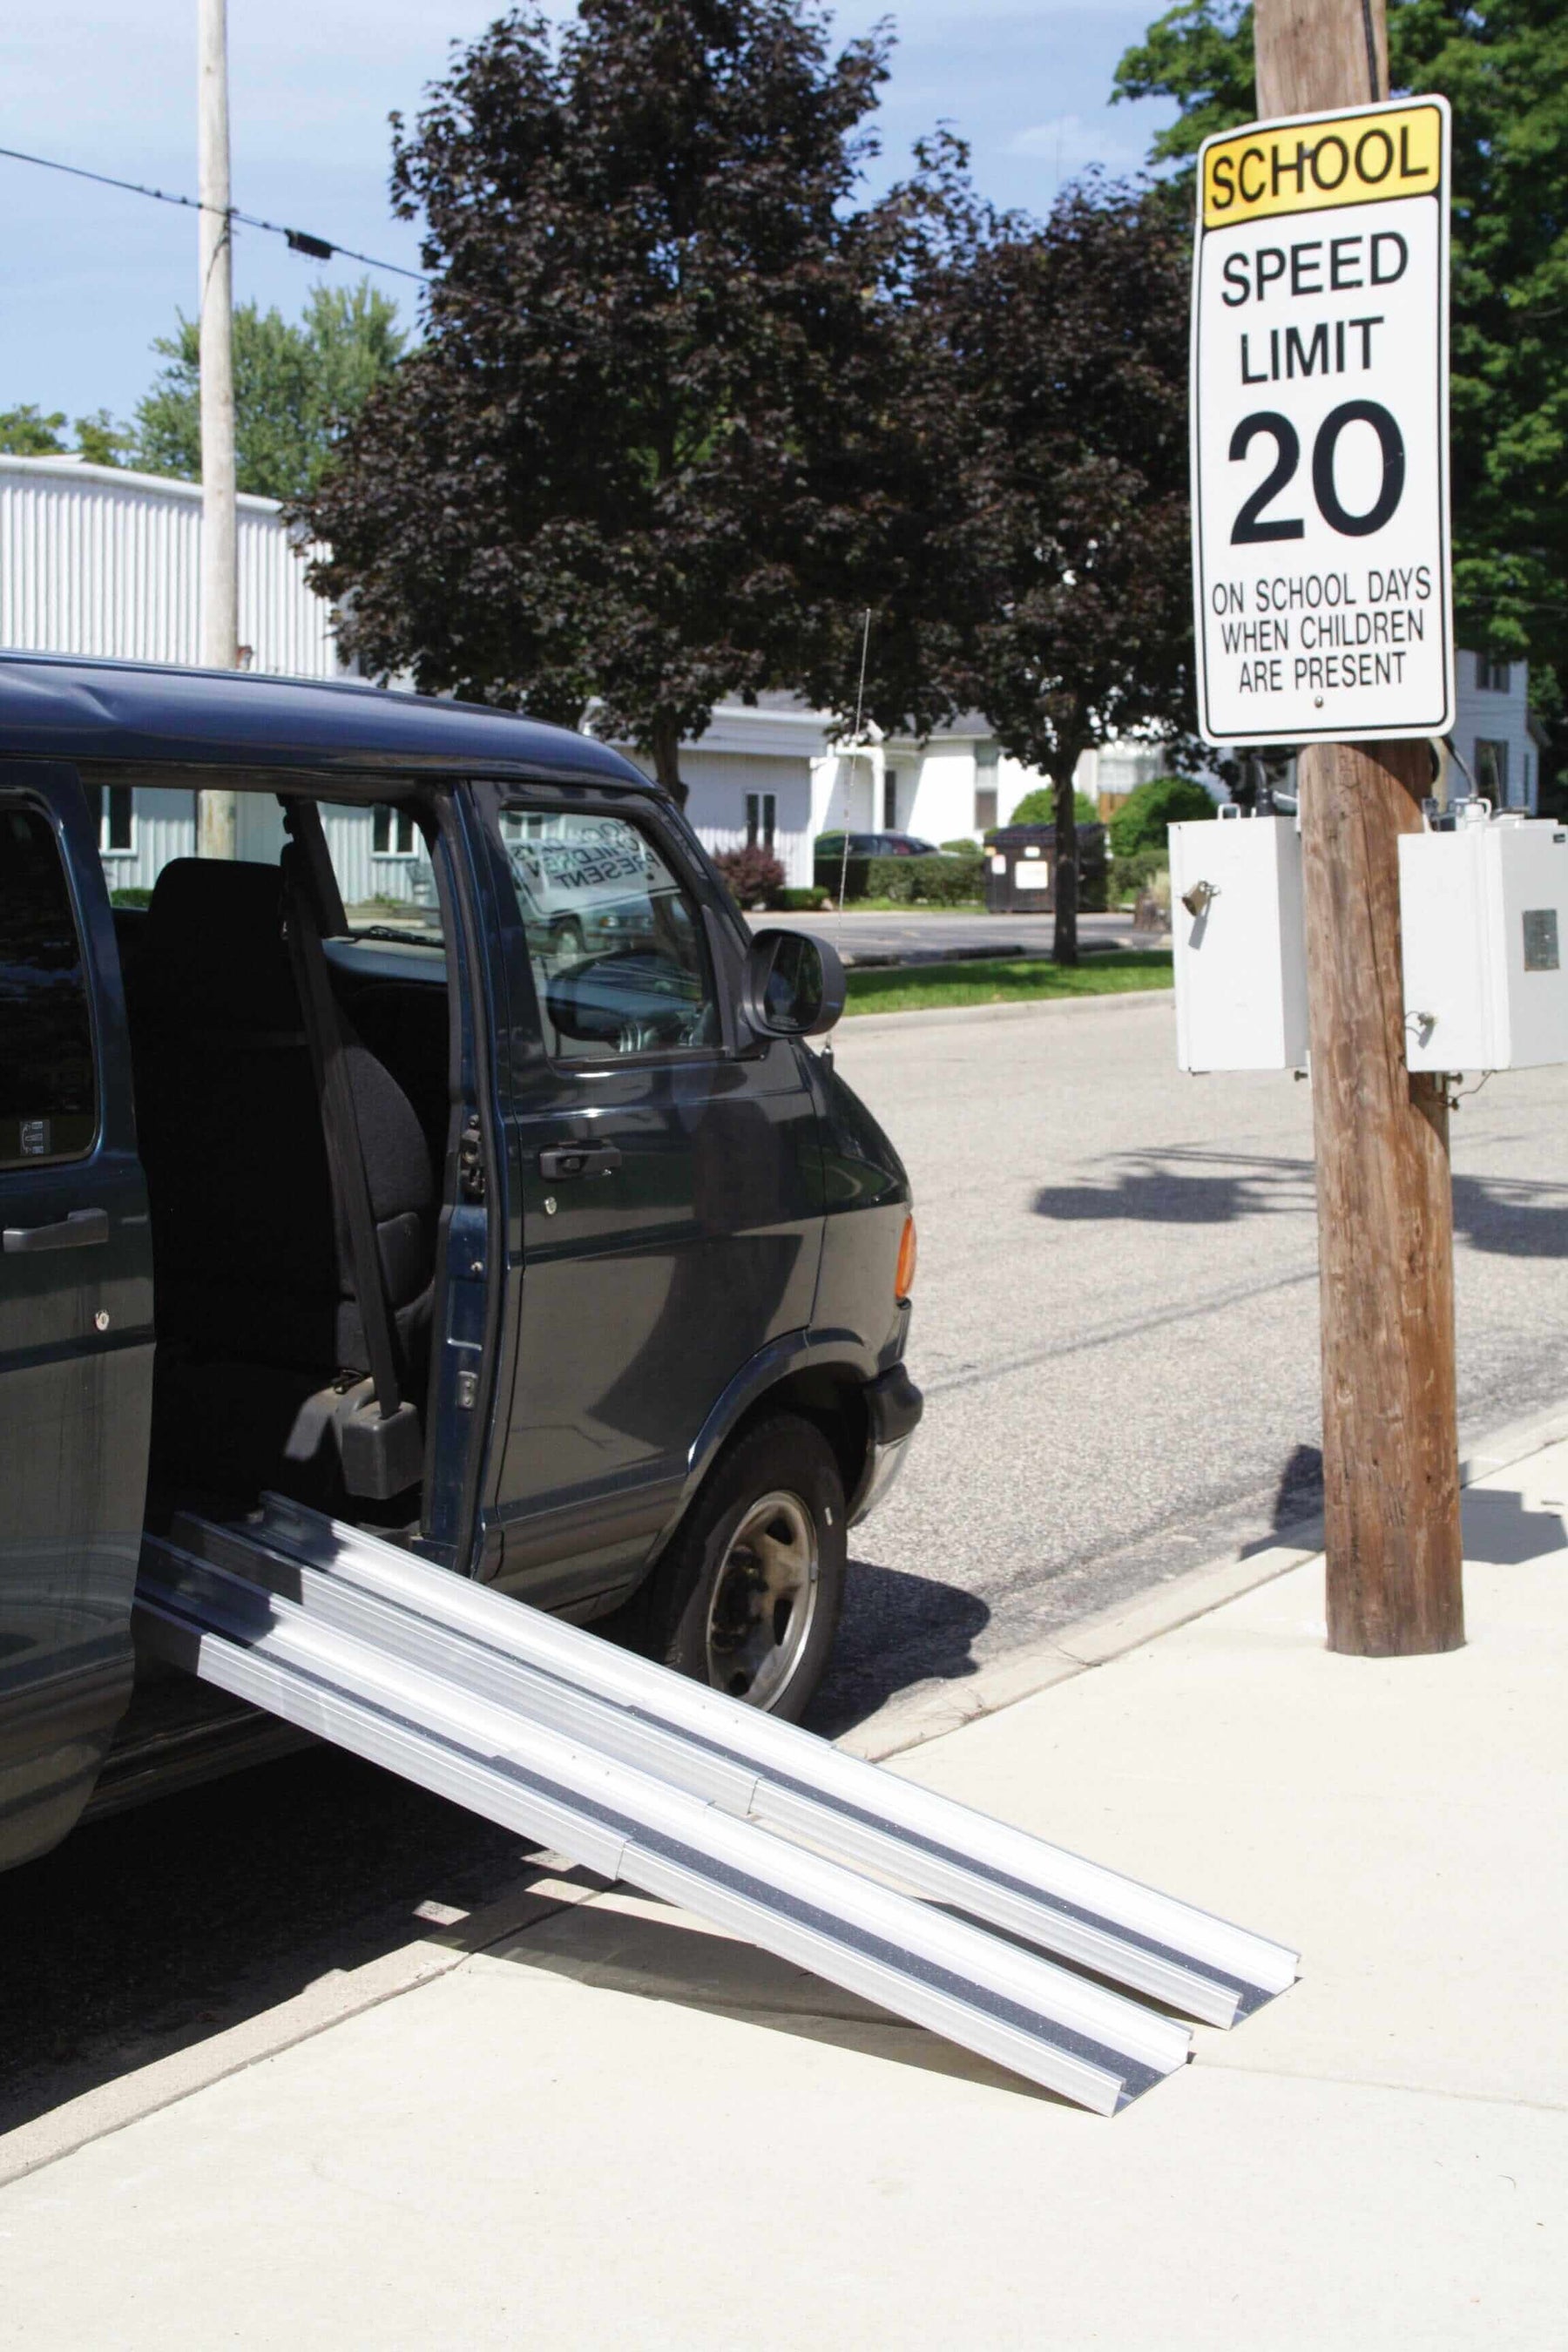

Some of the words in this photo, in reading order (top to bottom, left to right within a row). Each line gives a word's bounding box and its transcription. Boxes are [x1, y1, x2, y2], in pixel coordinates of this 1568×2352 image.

[1211, 125, 1429, 210] SCHOOL
[1221, 231, 1409, 307] SPEED
[1240, 315, 1384, 385] LIMIT
[1228, 399, 1406, 545] 20
[1212, 582, 1244, 616] ON
[1255, 572, 1356, 612] SCHOOL
[1369, 566, 1431, 603] DAYS
[1221, 618, 1288, 654] WHEN
[1301, 609, 1424, 649] CHILDREN
[1239, 659, 1282, 693] ARE
[1295, 652, 1406, 690] PRESENT
